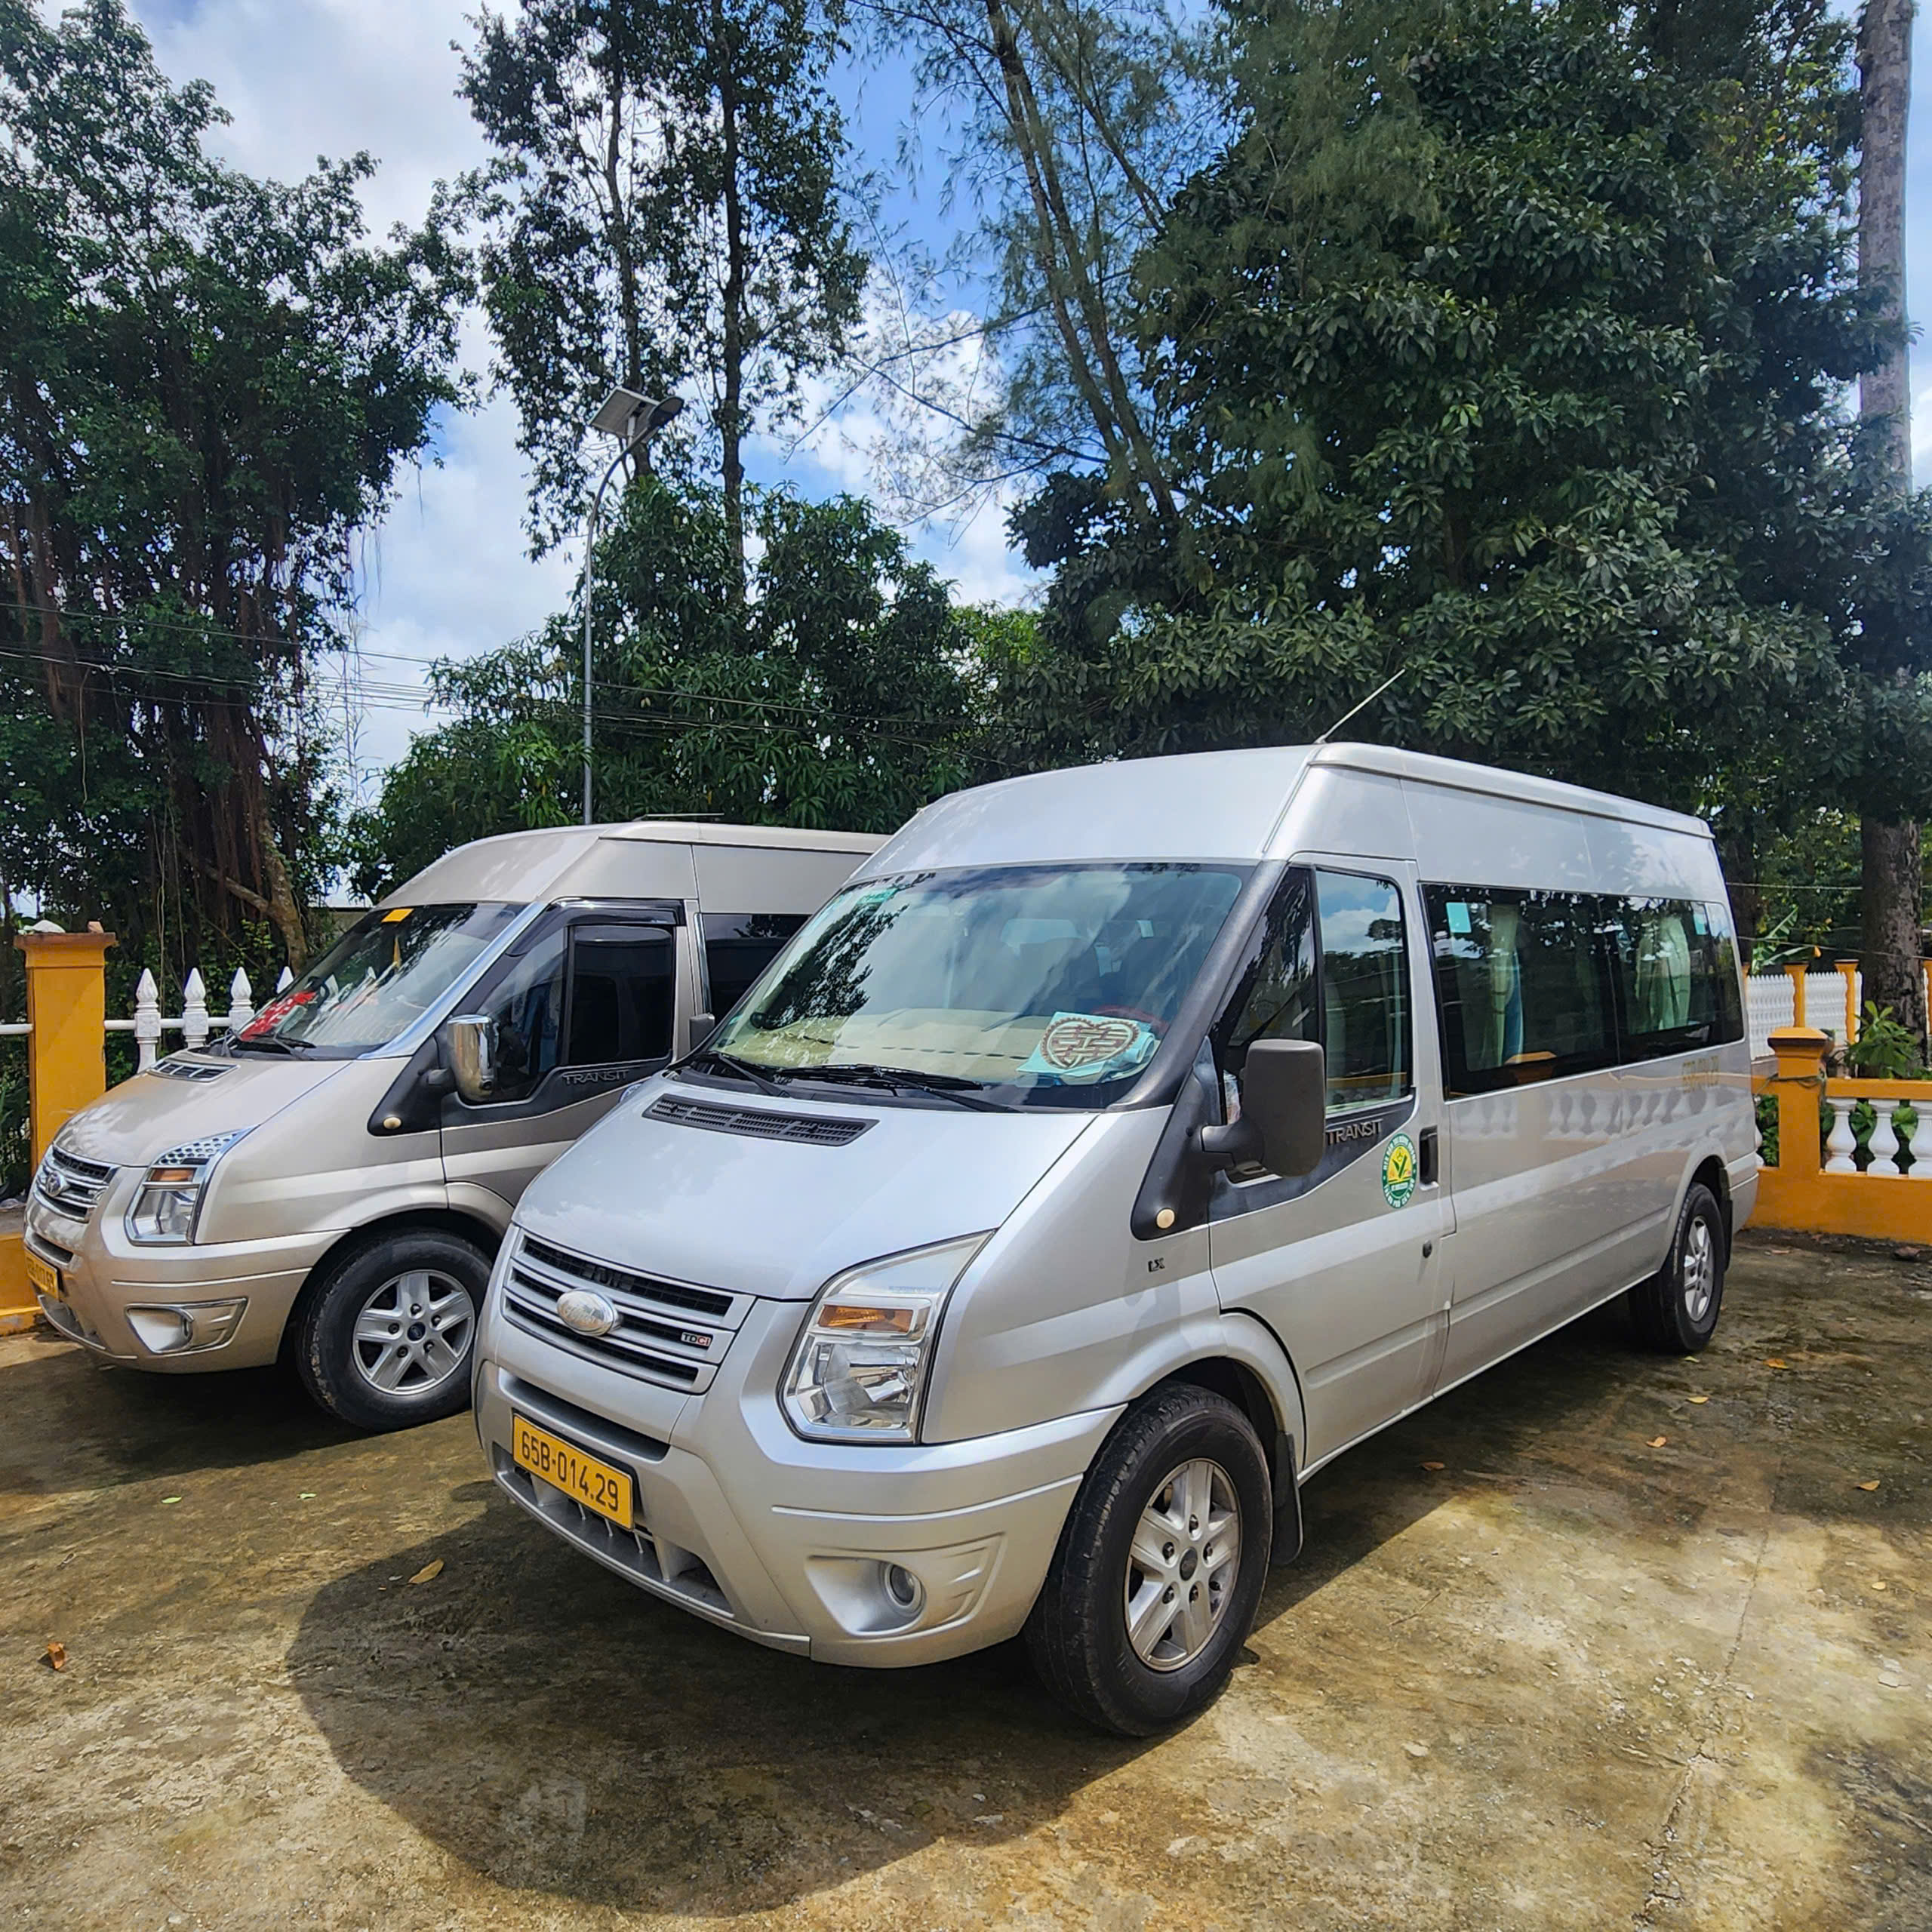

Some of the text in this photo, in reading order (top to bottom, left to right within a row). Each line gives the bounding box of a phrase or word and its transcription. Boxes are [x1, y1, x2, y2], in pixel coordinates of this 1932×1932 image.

[561, 1069, 629, 1084] TRANSIT
[1325, 1118, 1383, 1144] TRANSIT
[521, 1430, 619, 1512] 65B-014.29
